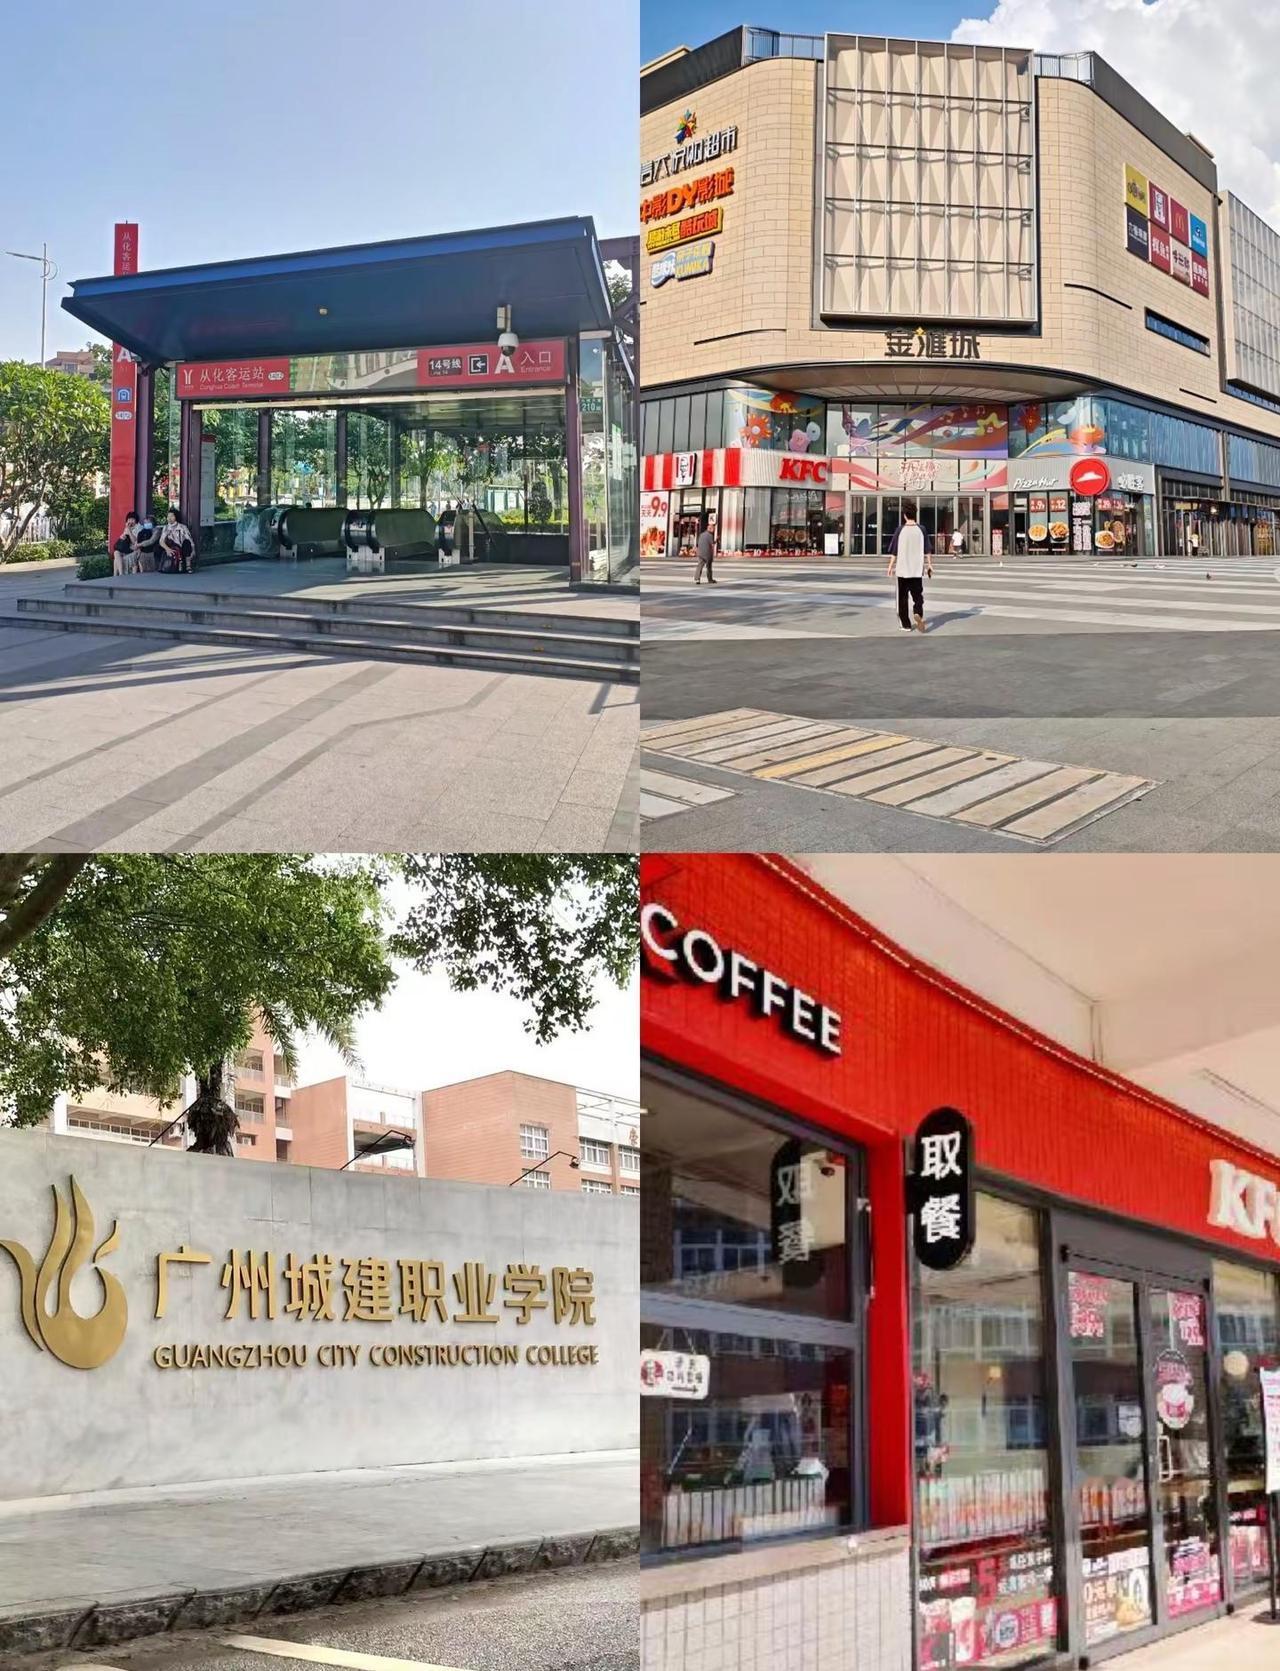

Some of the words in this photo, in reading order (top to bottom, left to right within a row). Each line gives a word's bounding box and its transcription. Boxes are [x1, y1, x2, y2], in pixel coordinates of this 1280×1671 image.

[429, 358, 462, 371] 14号线
[494, 352, 515, 374] A
[521, 351, 551, 365] 入口
[521, 366, 552, 374] Entrance
[200, 366, 264, 383] 从化客运站
[779, 458, 827, 483] KFC
[641, 902, 842, 1055] COFFEE
[920, 1130, 963, 1244] 取餐
[1207, 1159, 1280, 1250] KF
[154, 1244, 597, 1325] 广州城建职业学院
[153, 1343, 307, 1370] GUANGZHOU
[317, 1343, 361, 1368] CITY
[369, 1344, 519, 1367] CONSTRUCTION
[526, 1344, 599, 1366] COLLEGE
